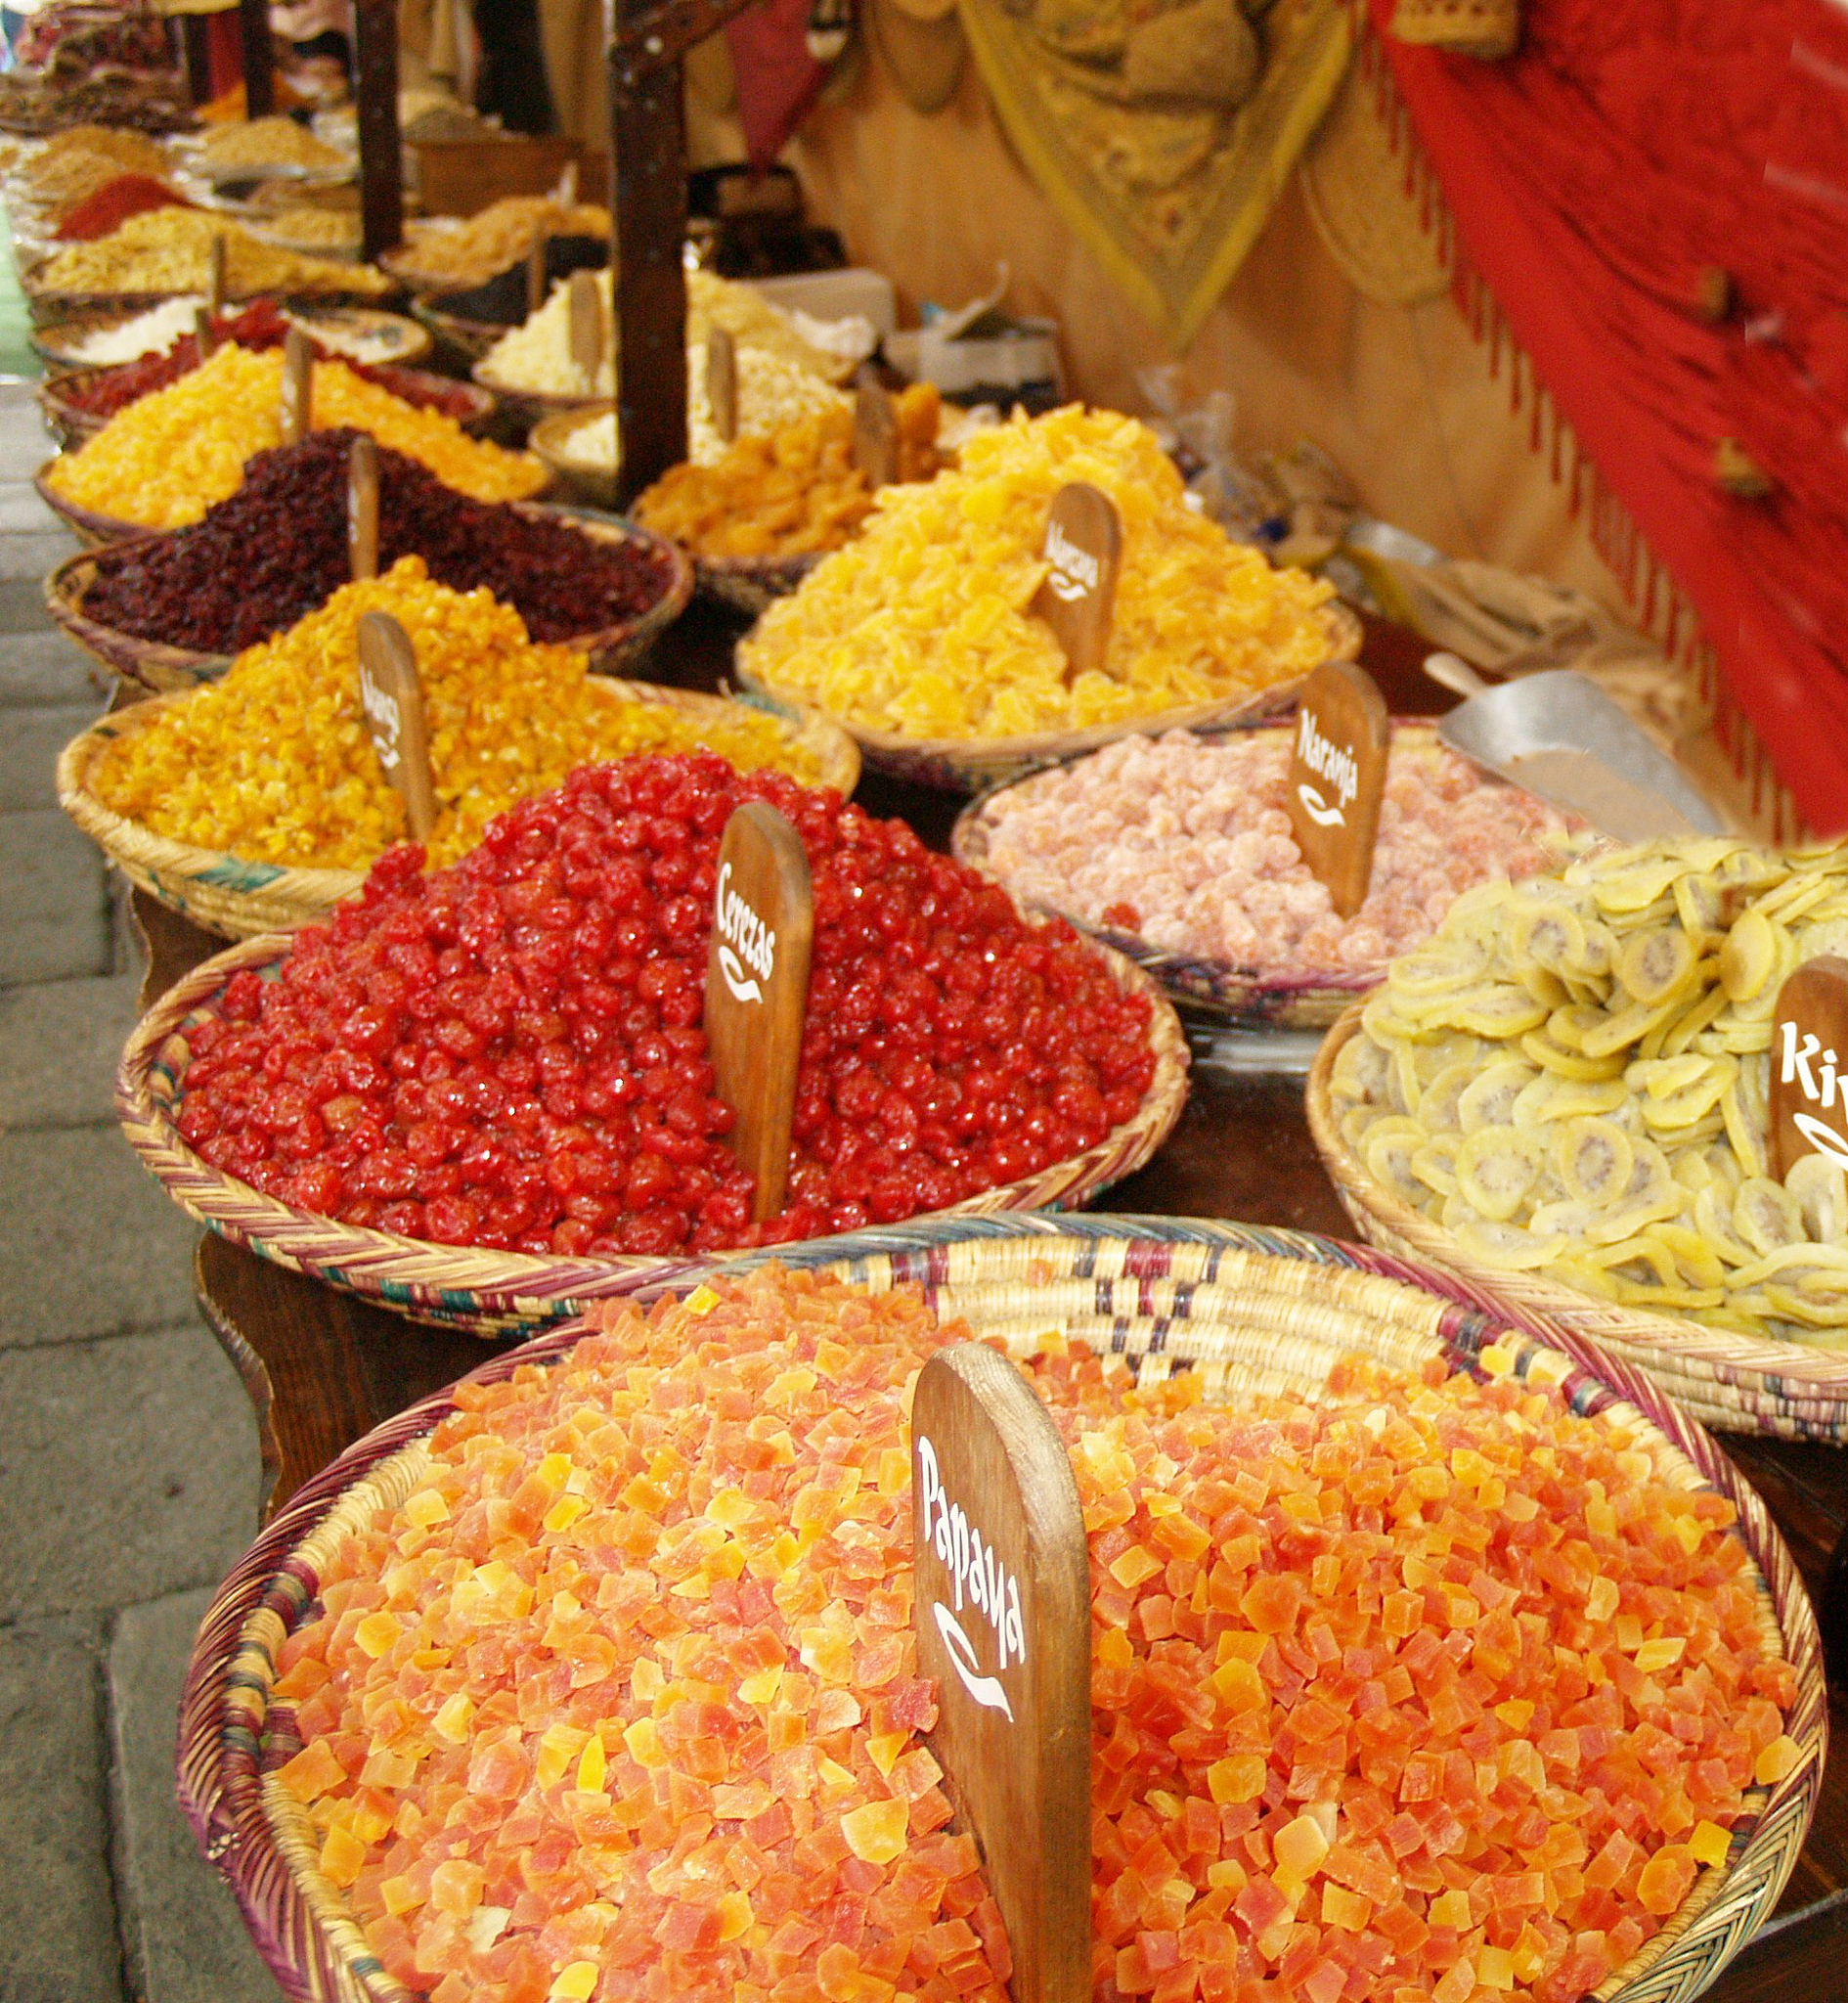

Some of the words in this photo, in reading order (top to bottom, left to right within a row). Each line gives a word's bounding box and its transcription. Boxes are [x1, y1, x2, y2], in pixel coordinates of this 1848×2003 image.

[1298, 707, 1358, 810] Naranja
[717, 862, 775, 981] Cerezas
[1781, 1021, 1848, 1125] Ki
[918, 1435, 1026, 1669] Papaya
